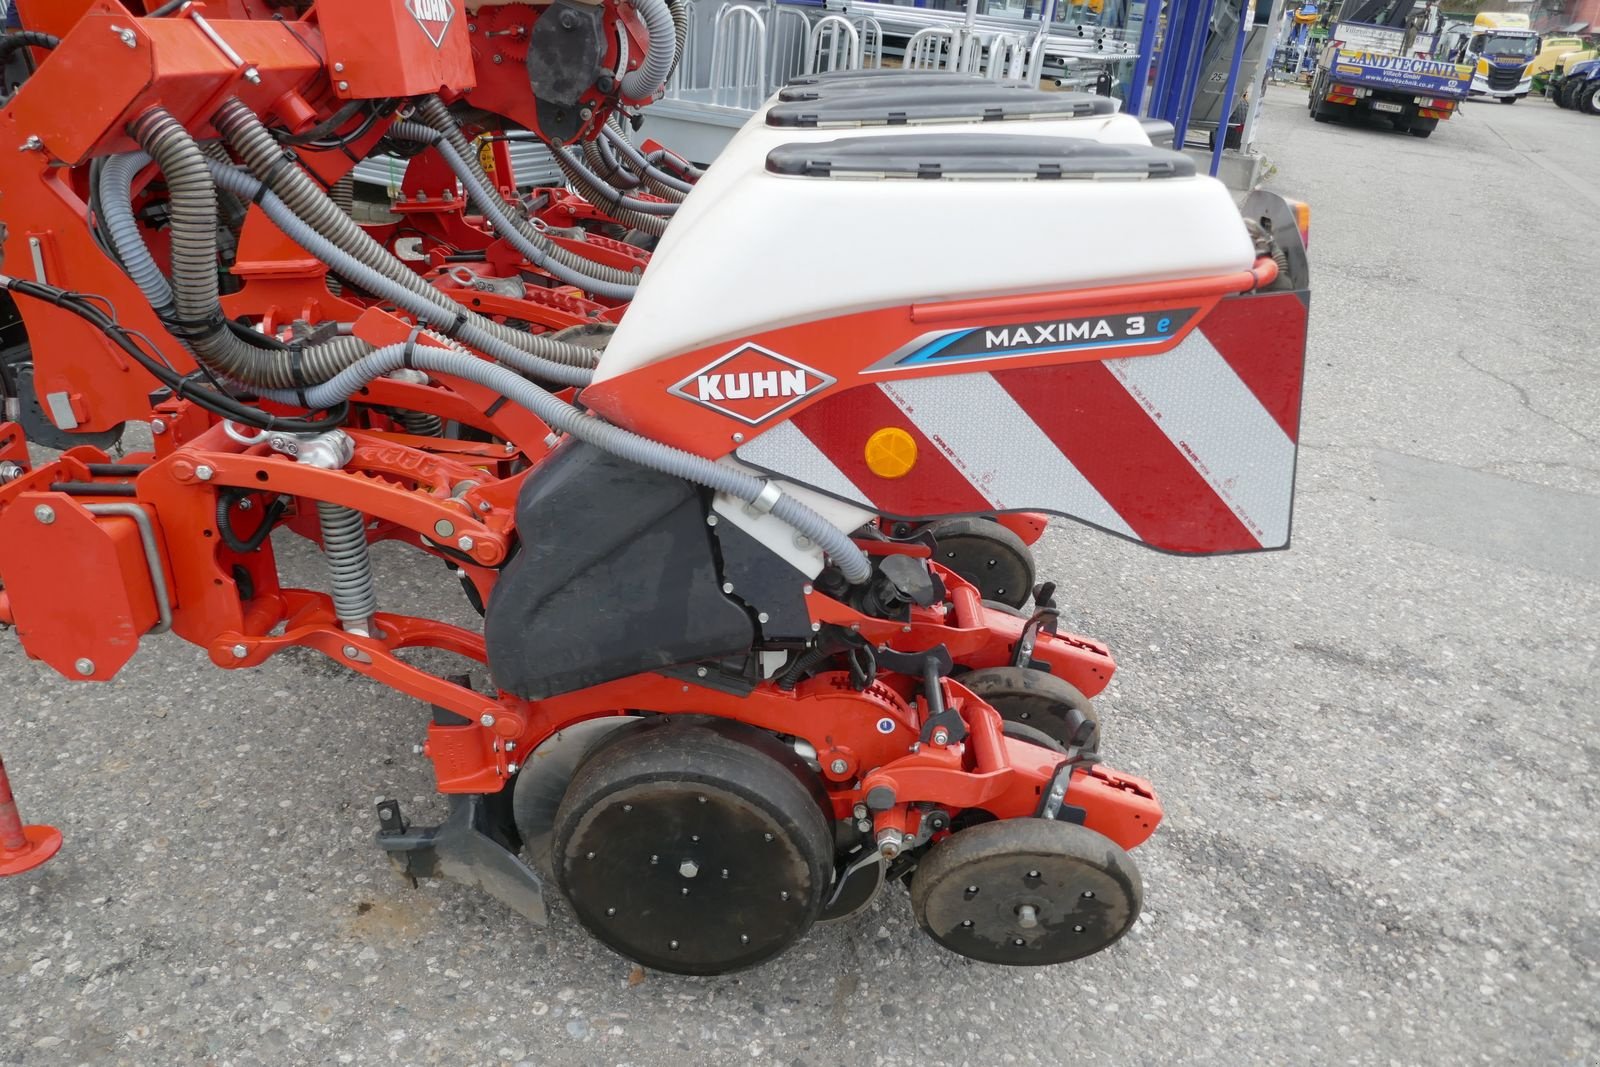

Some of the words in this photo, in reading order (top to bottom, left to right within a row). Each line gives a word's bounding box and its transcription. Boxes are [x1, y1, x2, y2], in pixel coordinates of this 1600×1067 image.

[414, 0, 449, 21] KUHN
[1211, 72, 1223, 81] 25
[1365, 75, 1434, 89] www.landtechnik.co.at
[1383, 70, 1401, 78] Villach
[985, 318, 1114, 349] MAXIMA
[1125, 316, 1146, 336] 3
[1156, 317, 1171, 333] e
[697, 369, 807, 401] KUHN
